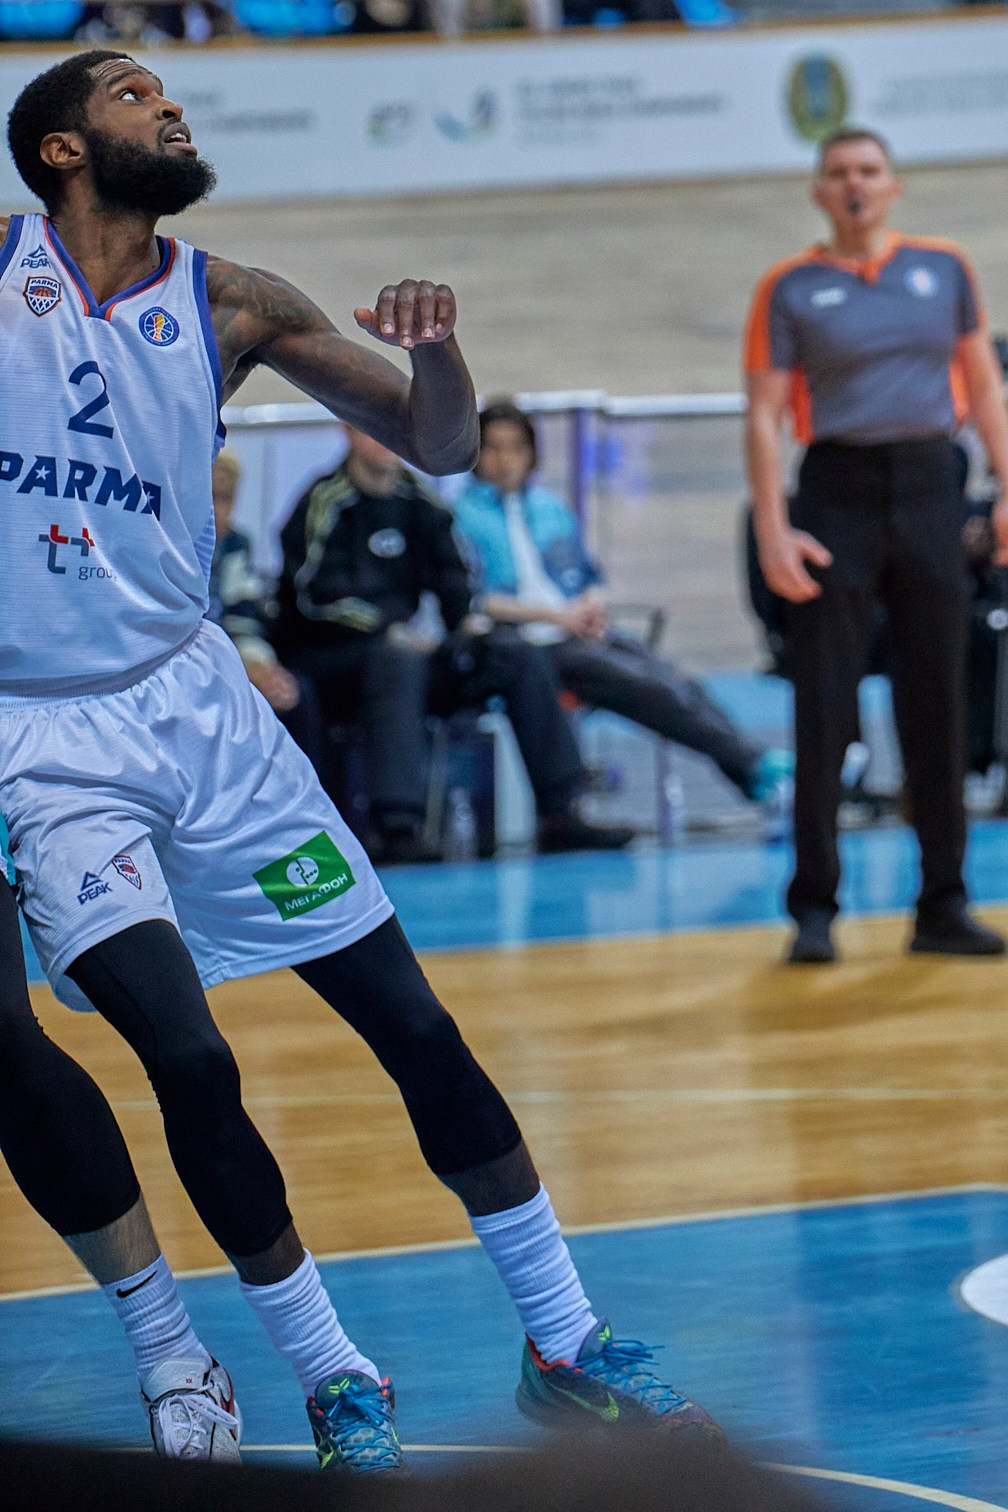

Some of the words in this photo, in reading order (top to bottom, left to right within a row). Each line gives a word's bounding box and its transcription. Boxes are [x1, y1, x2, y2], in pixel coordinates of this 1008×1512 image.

[31, 279, 58, 289] PARMA
[67, 360, 114, 439] 2
[0, 451, 161, 521] PARMA
[77, 882, 113, 905] PEAK
[284, 873, 348, 911] МЕГАФОН
